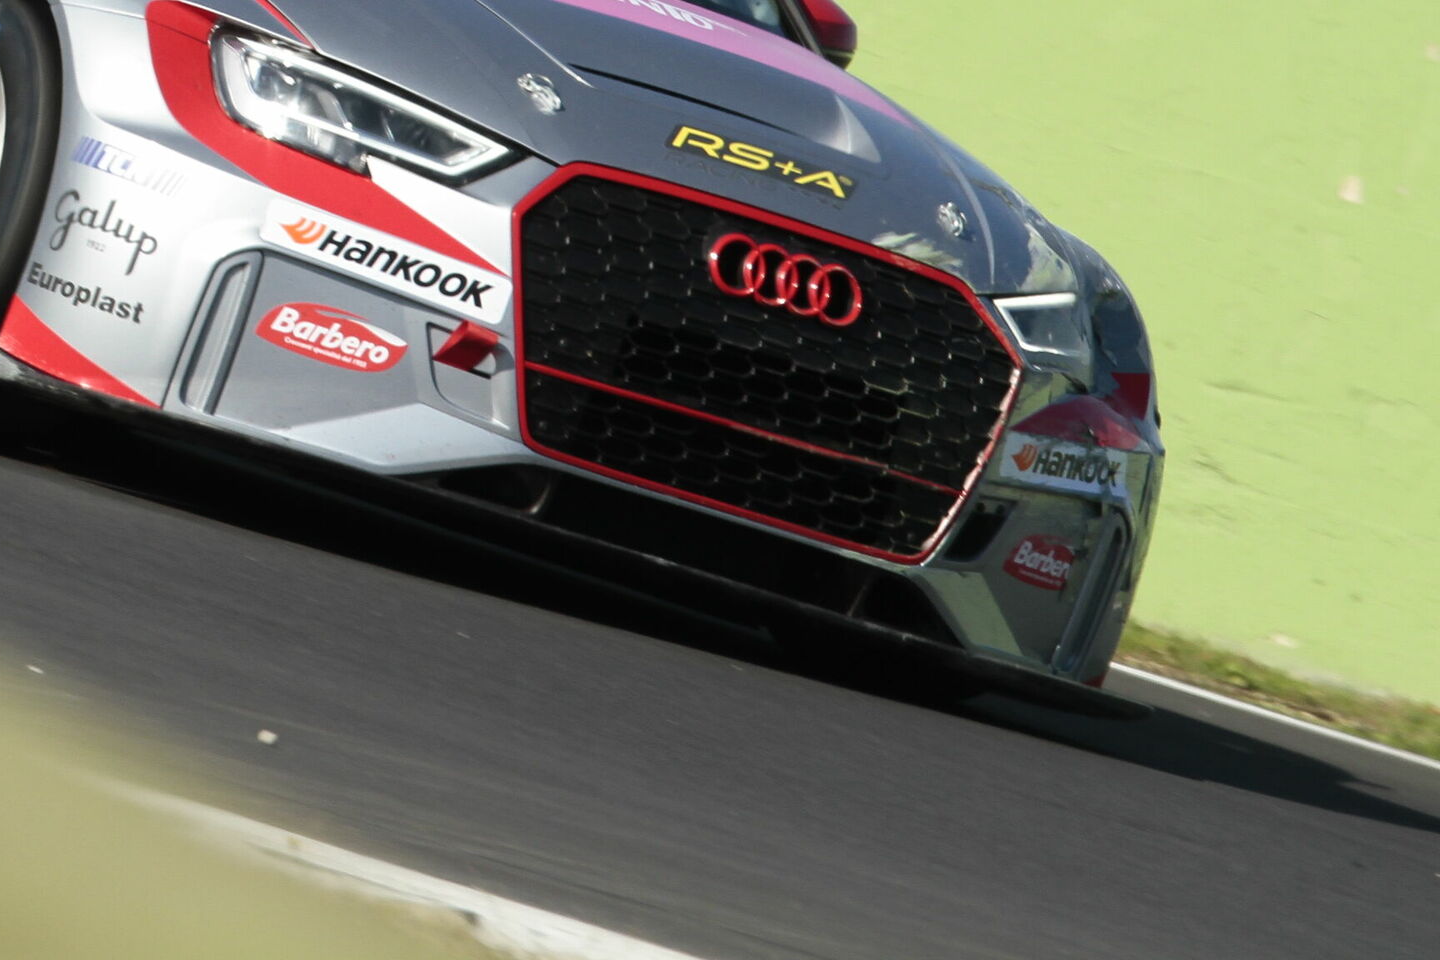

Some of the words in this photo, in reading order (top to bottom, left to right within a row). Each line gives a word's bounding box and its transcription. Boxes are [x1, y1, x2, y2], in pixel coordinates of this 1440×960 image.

[671, 125, 847, 199] RS+A
[49, 188, 158, 276] Galup
[27, 261, 145, 325] Europlast
[270, 306, 390, 365] Barbero
[1013, 539, 1073, 580] Barber
